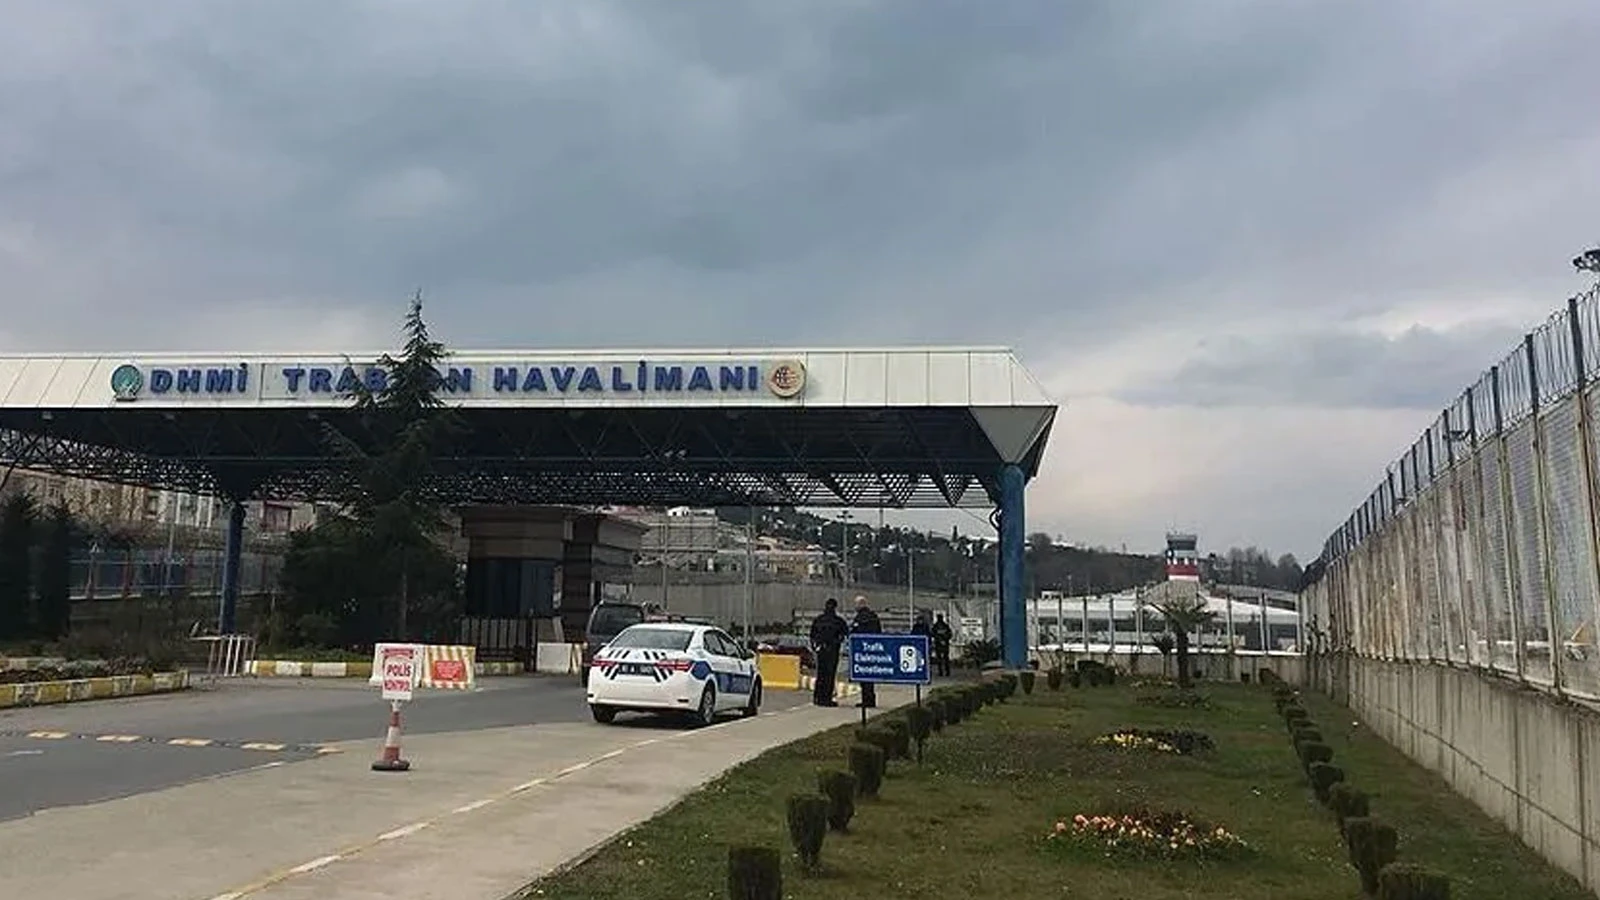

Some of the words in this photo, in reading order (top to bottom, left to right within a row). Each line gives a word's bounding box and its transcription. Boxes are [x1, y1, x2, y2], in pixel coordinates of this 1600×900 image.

[150, 362, 249, 394] DHMİ
[282, 366, 473, 393] TRABN
[493, 360, 759, 393] HAVALİMANI
